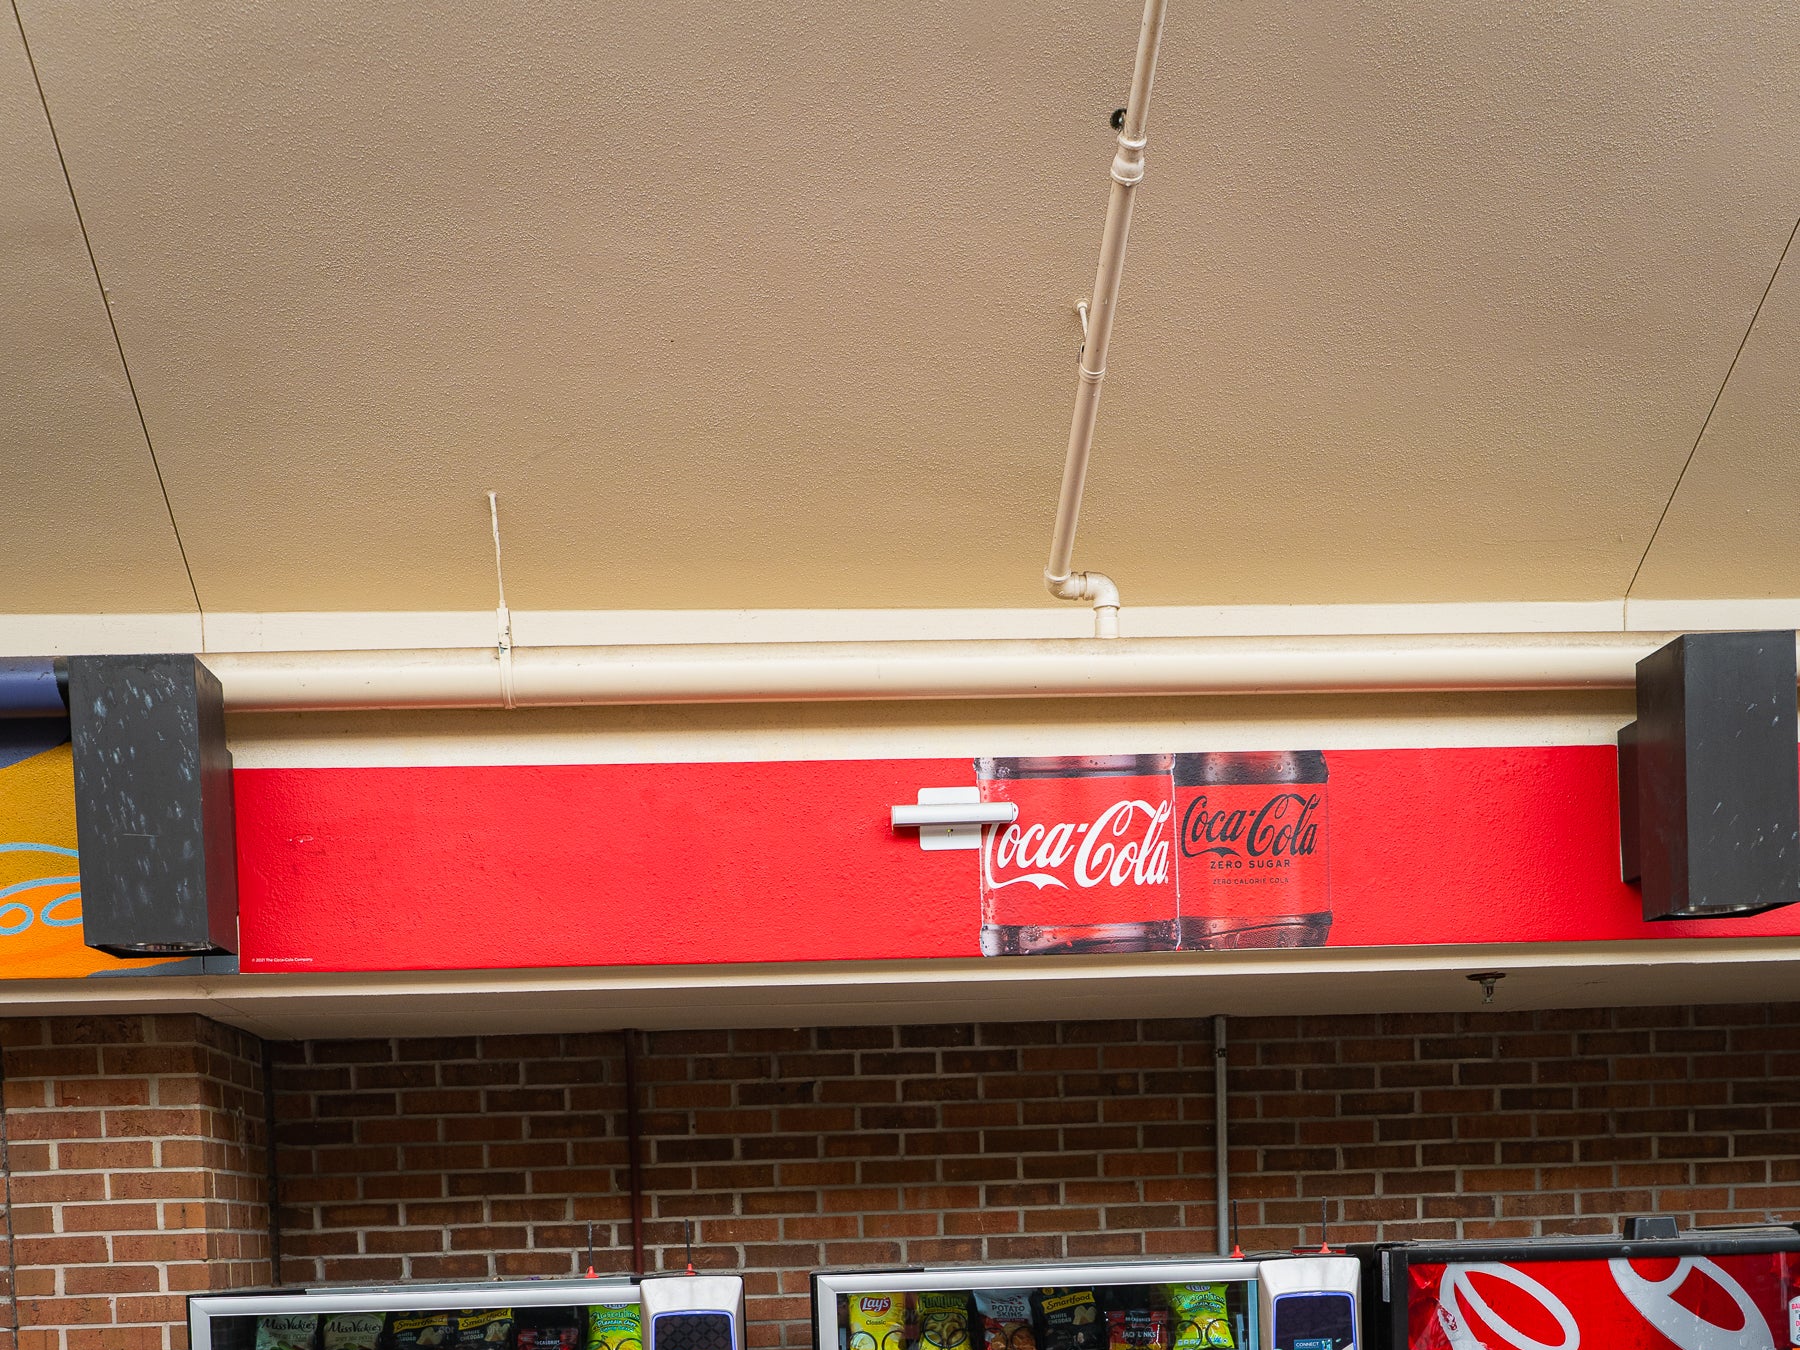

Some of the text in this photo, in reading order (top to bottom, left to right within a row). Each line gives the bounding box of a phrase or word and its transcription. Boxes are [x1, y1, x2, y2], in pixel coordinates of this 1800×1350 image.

[1181, 793, 1318, 858] Coca-Cola
[984, 800, 1170, 890] Coca-Cola
[1210, 859, 1290, 869] ZERO SUGAR
[862, 1296, 889, 1312] Lay's
[1046, 1293, 1091, 1310] Smartfood
[262, 1316, 316, 1332] Miss Vickie's
[328, 1320, 382, 1334] Miss Vickie's
[461, 1309, 508, 1329] Smartfood
